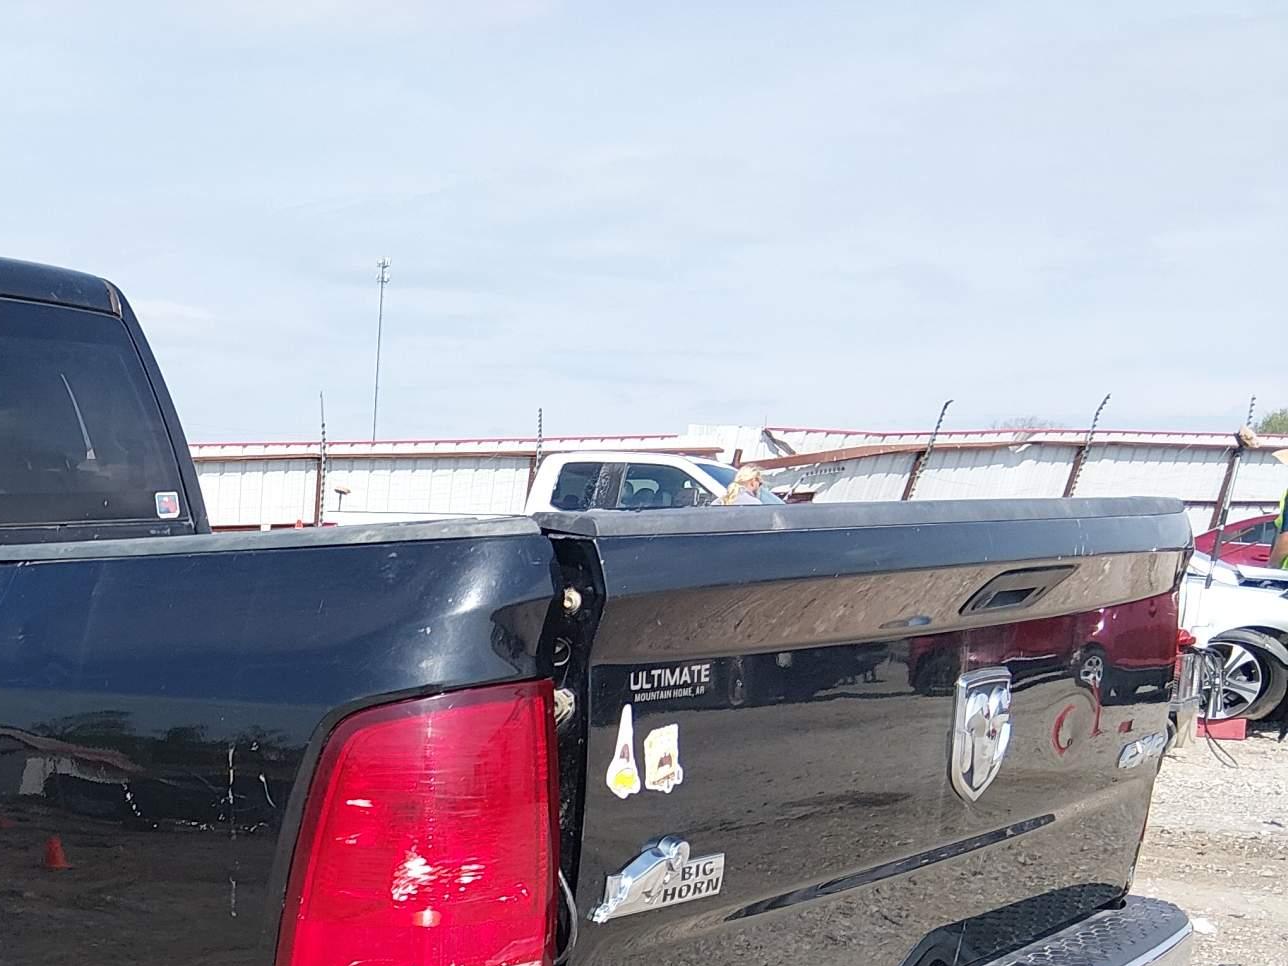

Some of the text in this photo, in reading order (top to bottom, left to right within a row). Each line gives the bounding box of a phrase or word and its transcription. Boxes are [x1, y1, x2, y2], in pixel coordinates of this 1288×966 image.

[630, 664, 710, 691] ULTIMATE
[634, 690, 672, 703] MOUNTAIN
[673, 687, 694, 699] HOME,
[681, 861, 714, 881] BIG
[662, 877, 720, 903] HORN
